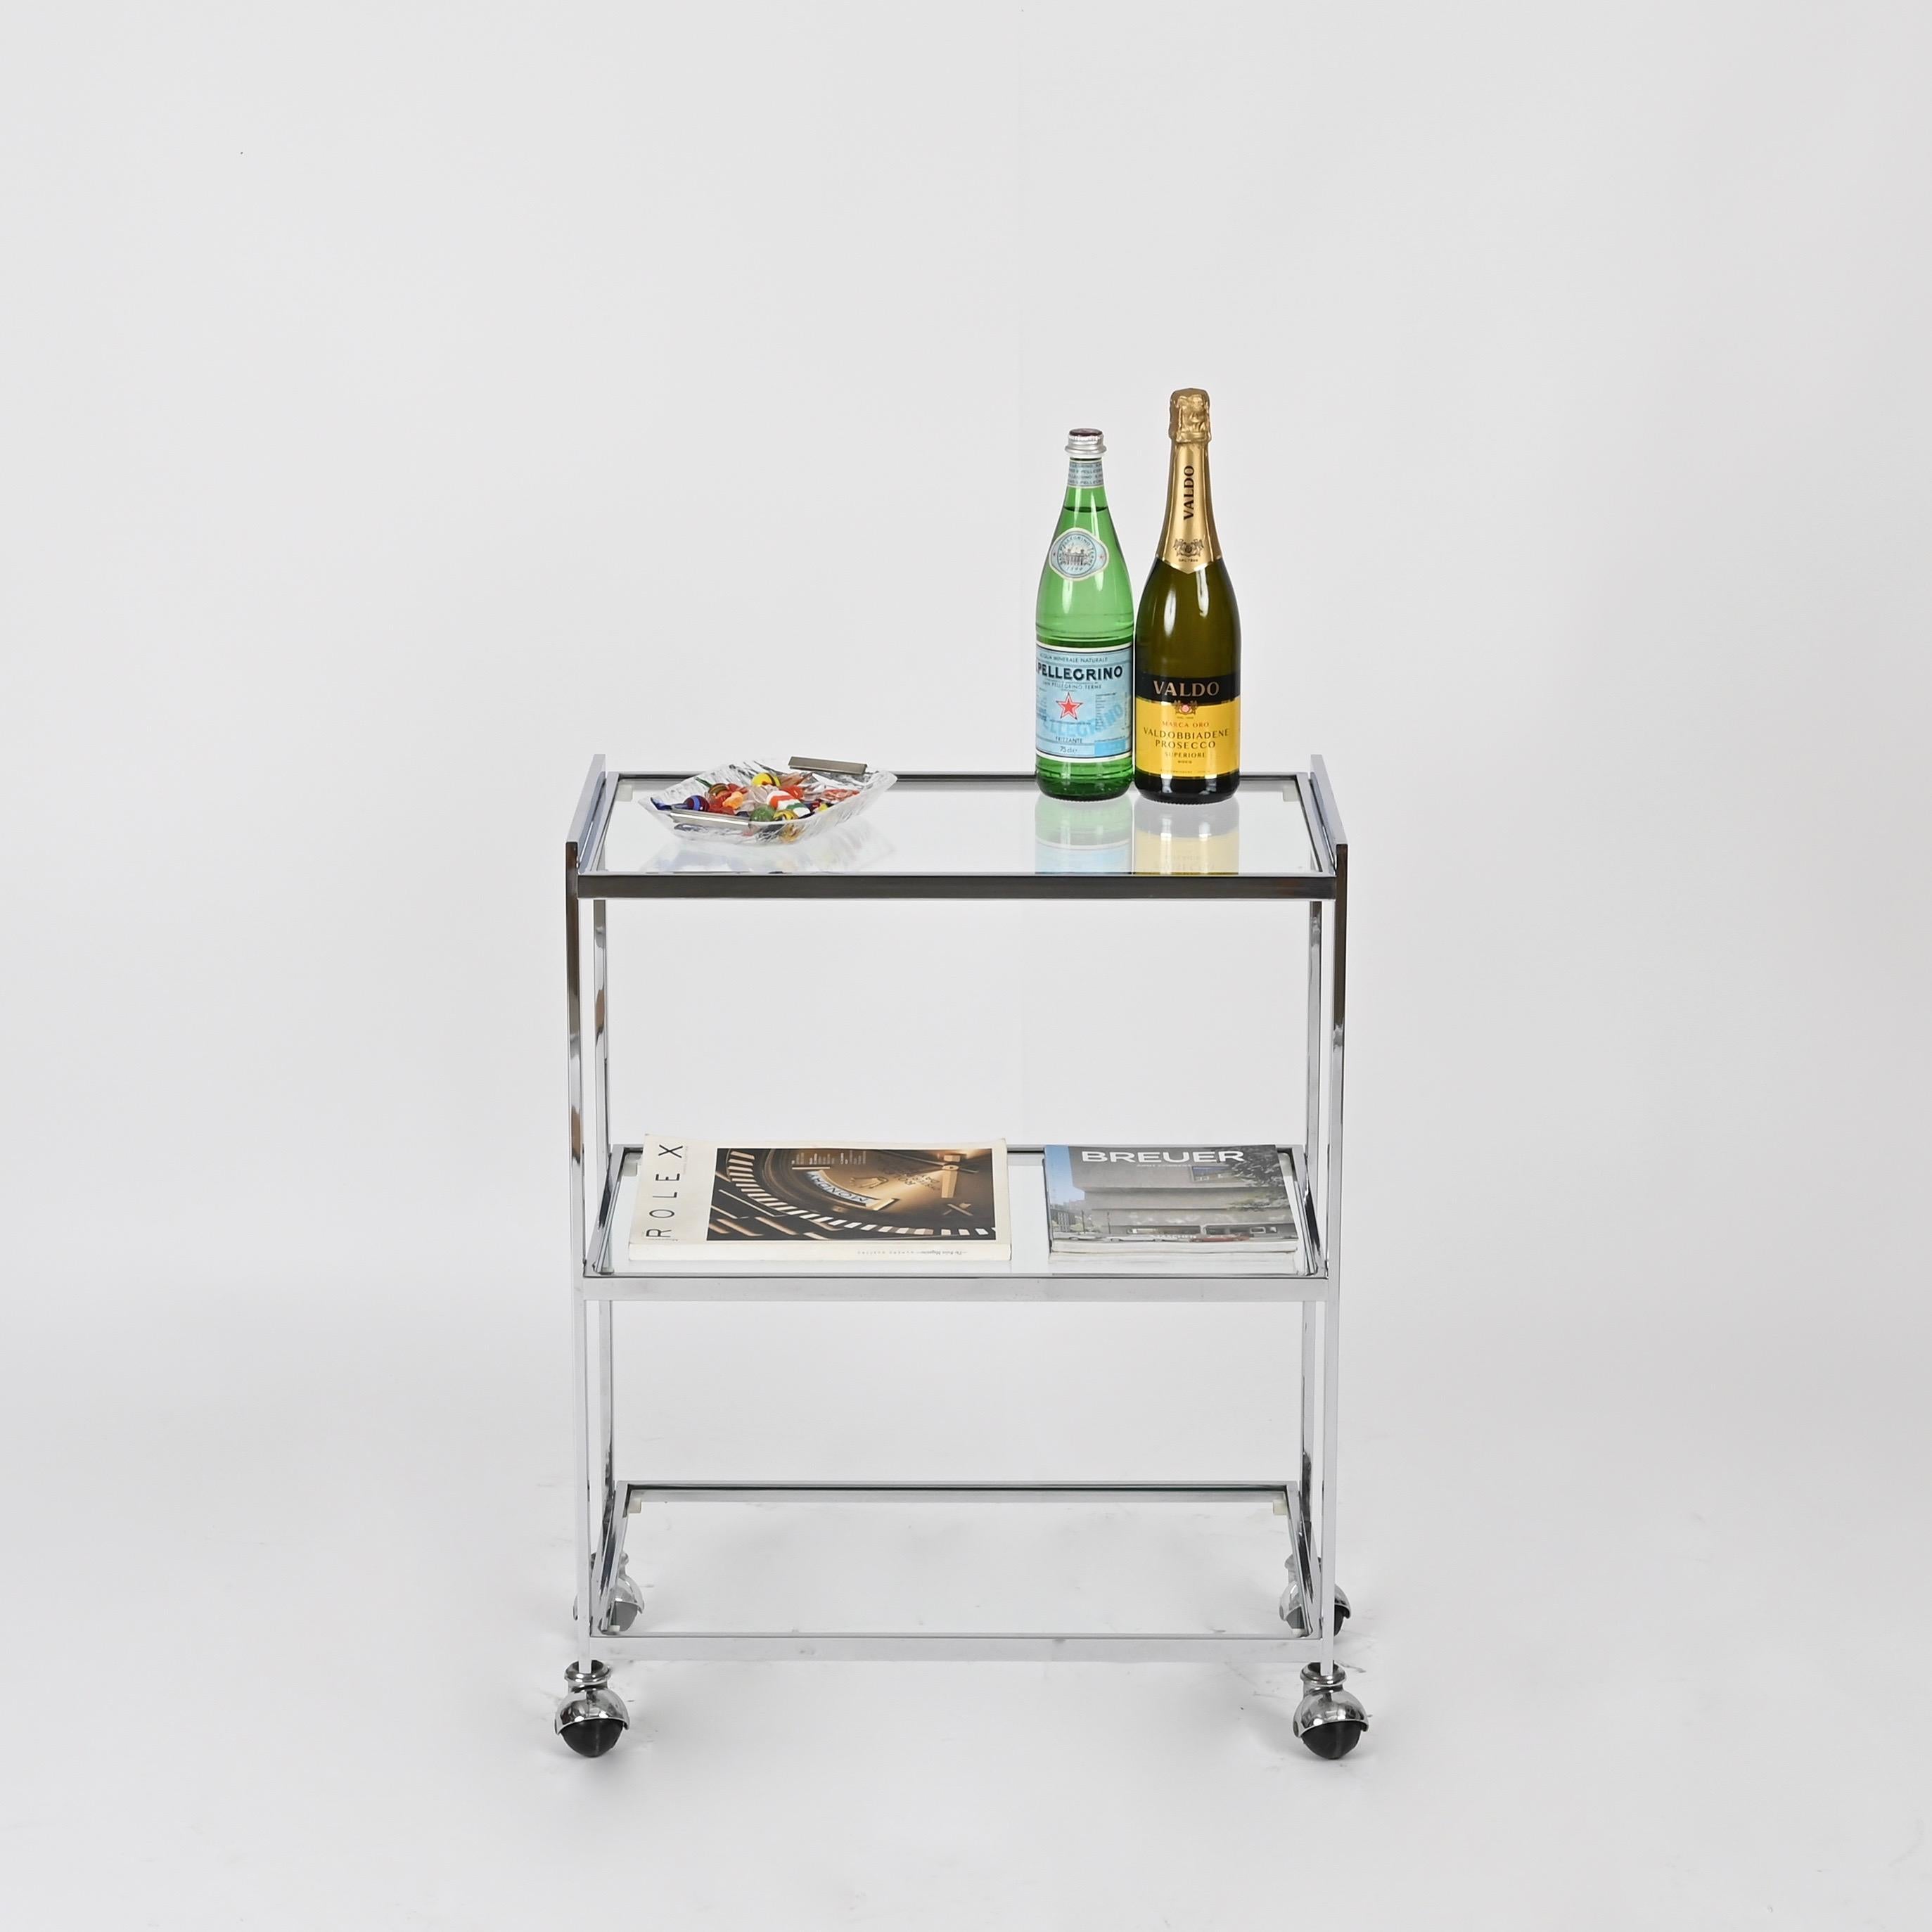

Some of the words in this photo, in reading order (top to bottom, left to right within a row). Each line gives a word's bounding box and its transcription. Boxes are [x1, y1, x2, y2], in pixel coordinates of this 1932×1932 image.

[1183, 466, 1195, 520] VALDO
[1153, 680, 1220, 697] VALDO
[1144, 727, 1229, 740] VALDOBBIADENE
[1155, 739, 1216, 749] PROSECCO
[1081, 1150, 1244, 1164] BREUER
[646, 1144, 683, 1238] ROLEX
